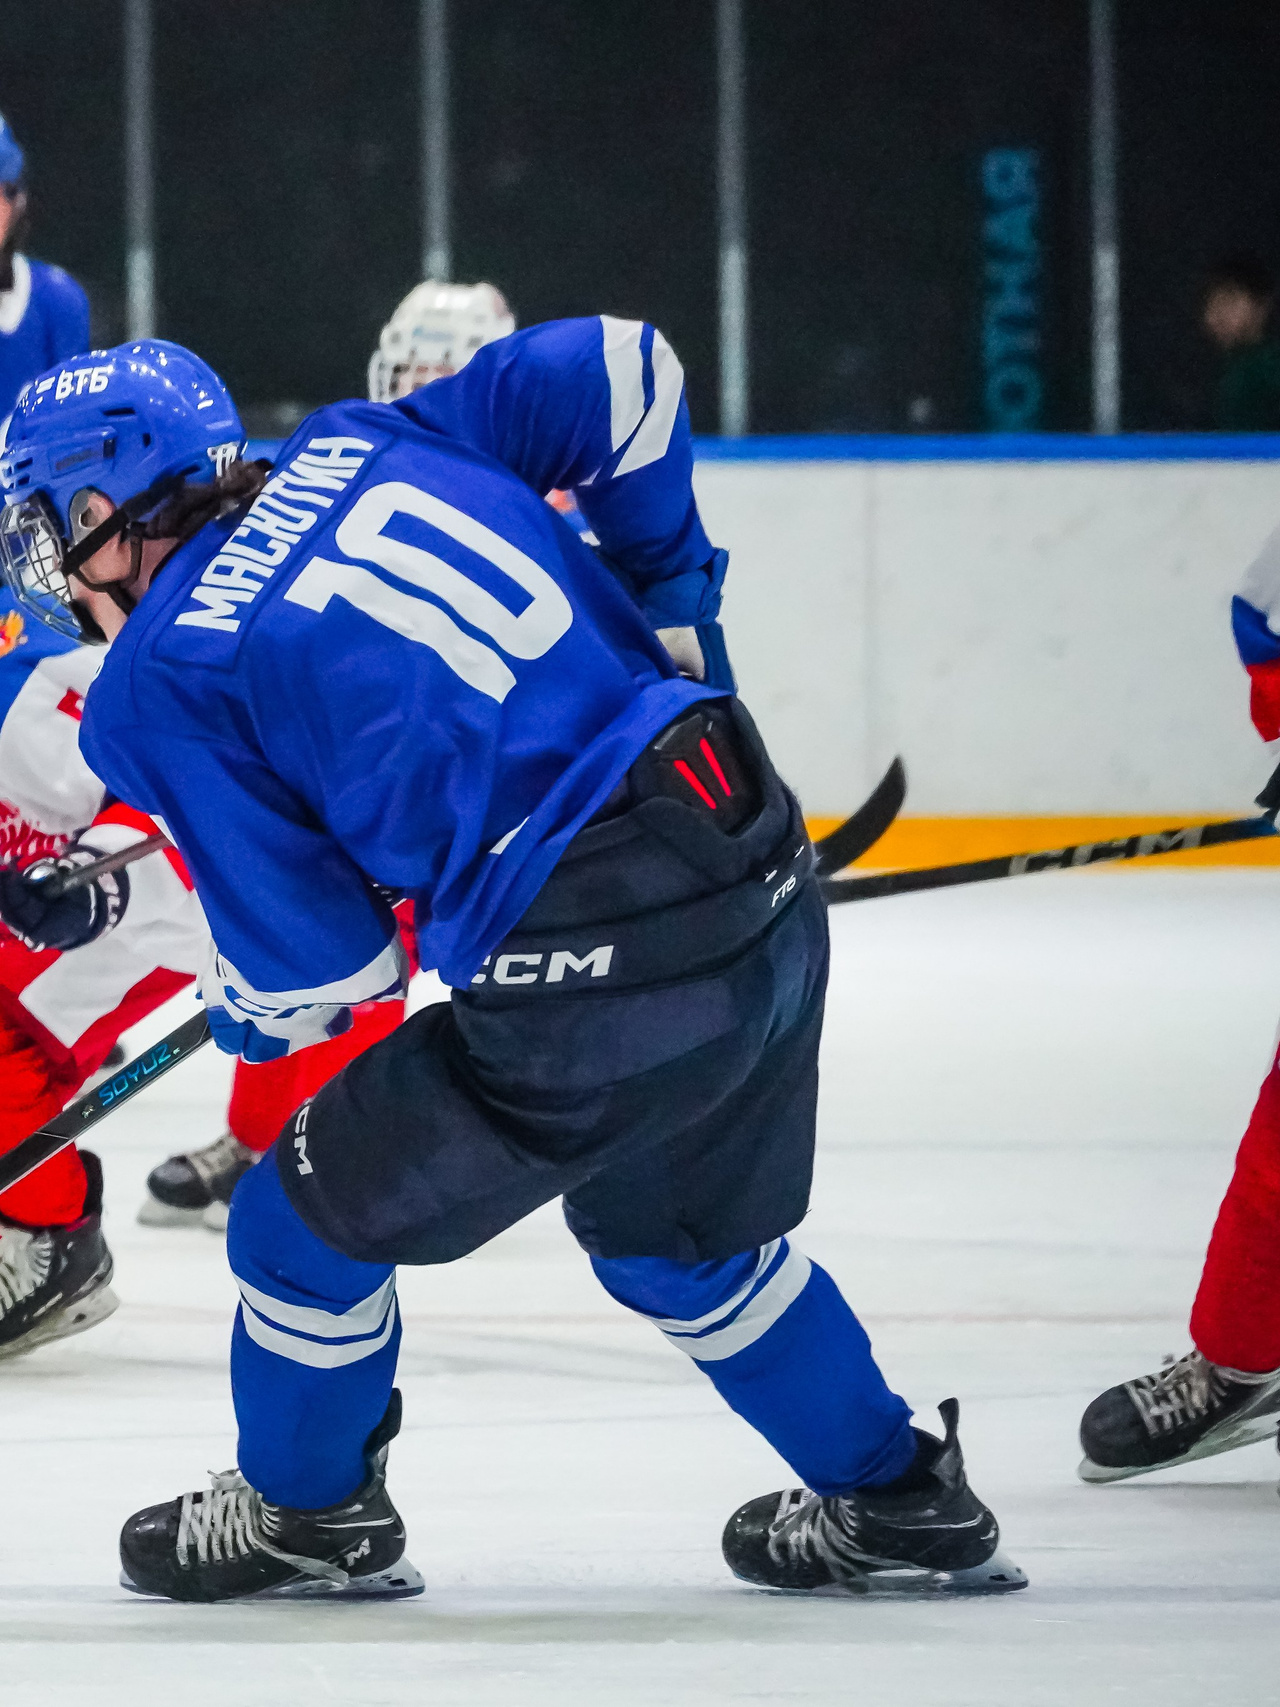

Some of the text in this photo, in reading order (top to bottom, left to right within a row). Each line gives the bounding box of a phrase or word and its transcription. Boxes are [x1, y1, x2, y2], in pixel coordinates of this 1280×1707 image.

[982, 149, 1042, 433] ОТНАЯ
[55, 367, 114, 400] ВТБ
[174, 436, 375, 633] МАСЮТИН
[283, 481, 573, 704] 10
[1008, 826, 1204, 876] CCM
[98, 1043, 171, 1106] SOYUZ
[294, 1097, 313, 1176] CM
